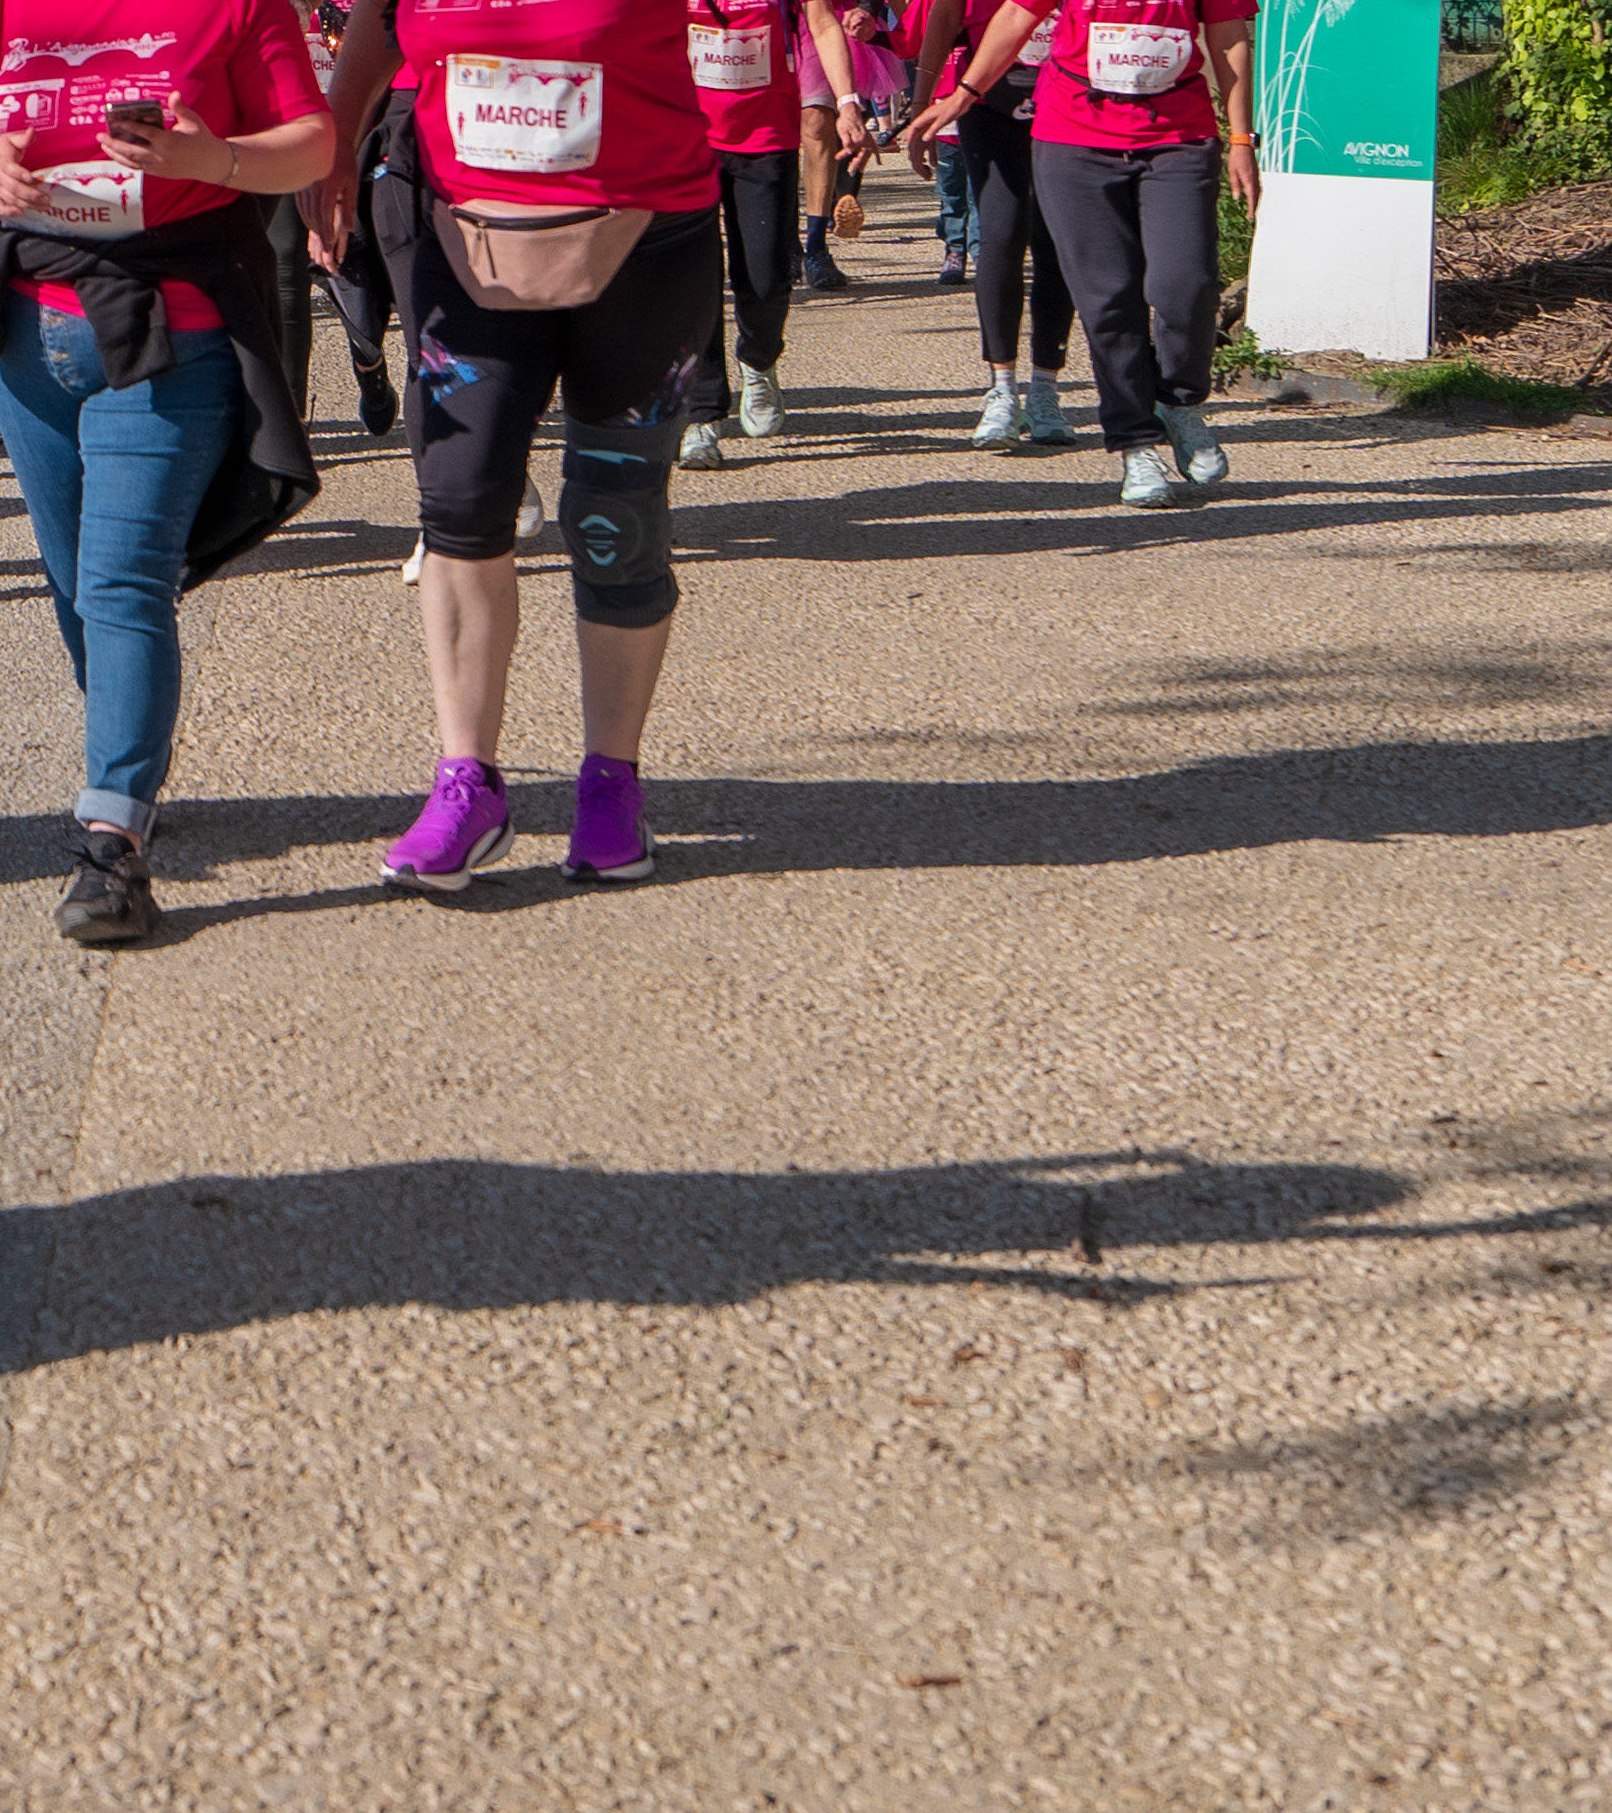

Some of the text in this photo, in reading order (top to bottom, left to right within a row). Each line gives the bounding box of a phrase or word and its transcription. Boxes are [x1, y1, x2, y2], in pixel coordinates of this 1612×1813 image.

[313, 60, 336, 71] CHE
[704, 53, 756, 66] MARCHE
[1109, 54, 1170, 68] MARCHE
[475, 103, 568, 129] MARCHE
[1343, 141, 1409, 158] AVIGNON
